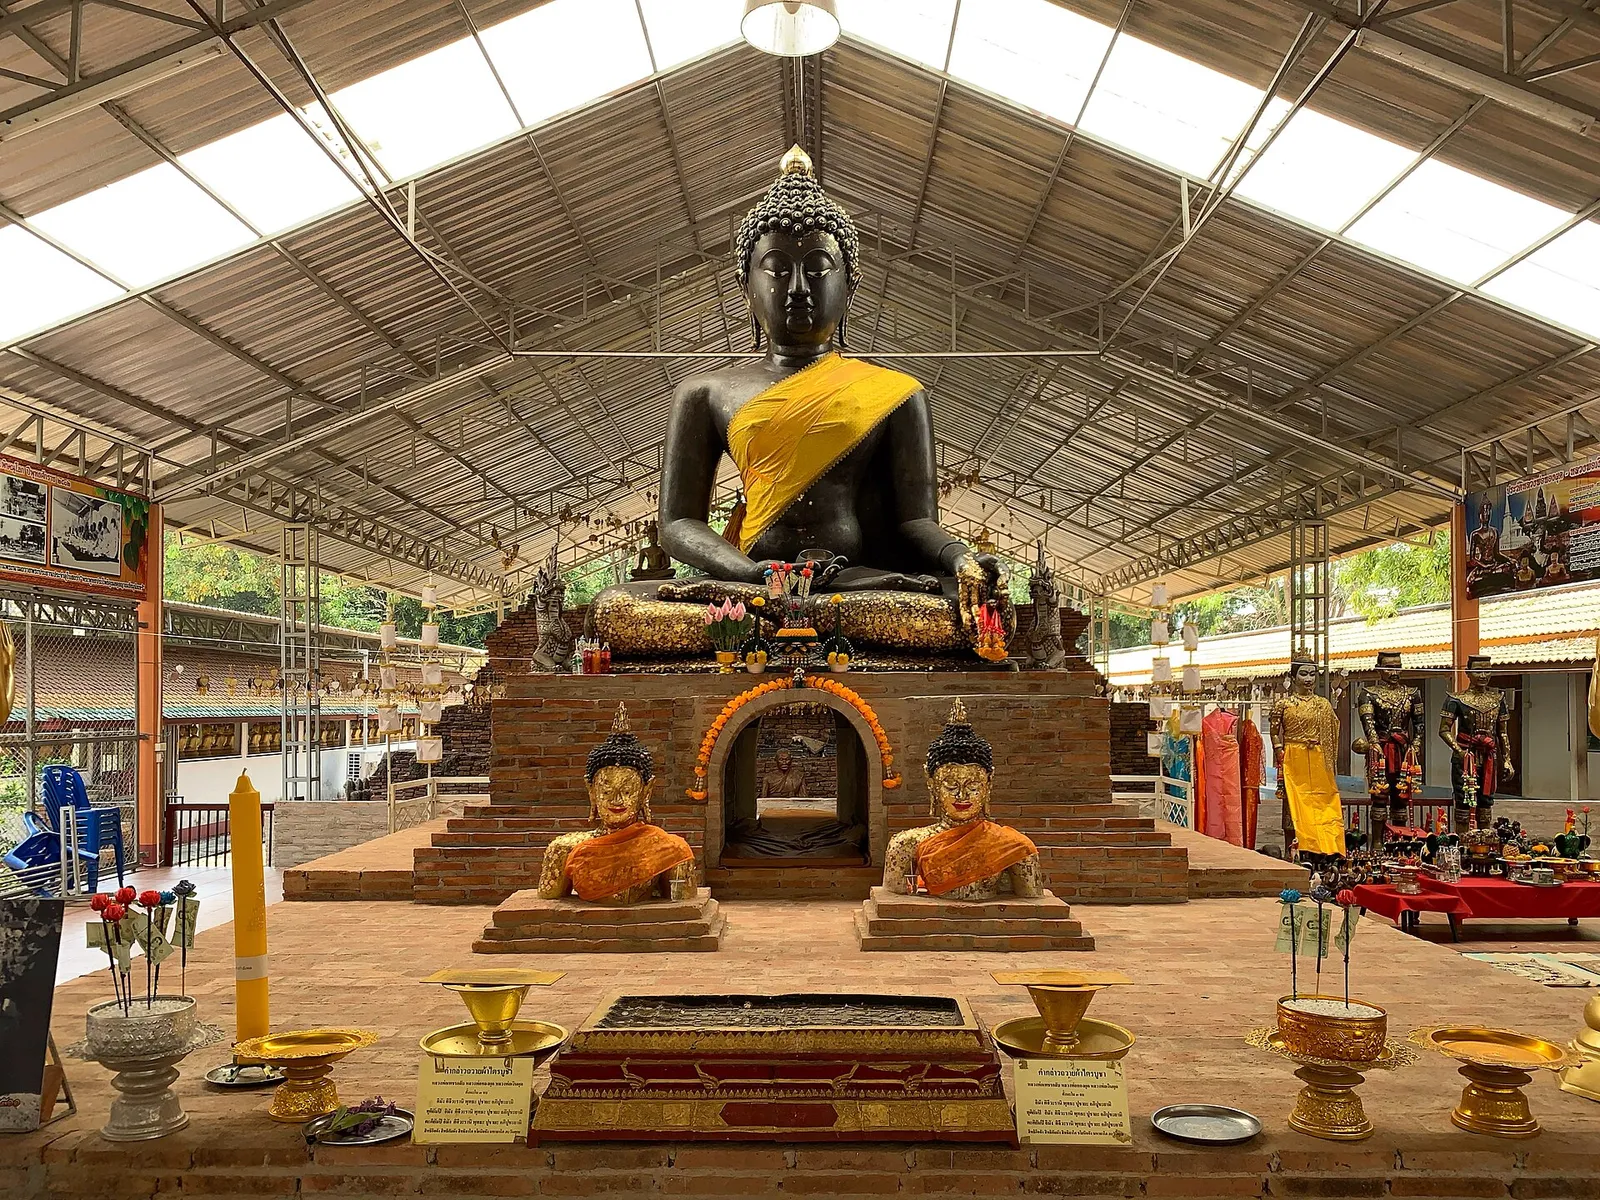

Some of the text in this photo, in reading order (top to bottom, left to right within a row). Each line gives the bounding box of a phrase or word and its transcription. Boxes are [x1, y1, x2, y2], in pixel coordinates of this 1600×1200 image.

[1038, 1068, 1106, 1079] คำกล่าวถวายผ้าไตรบูชา
